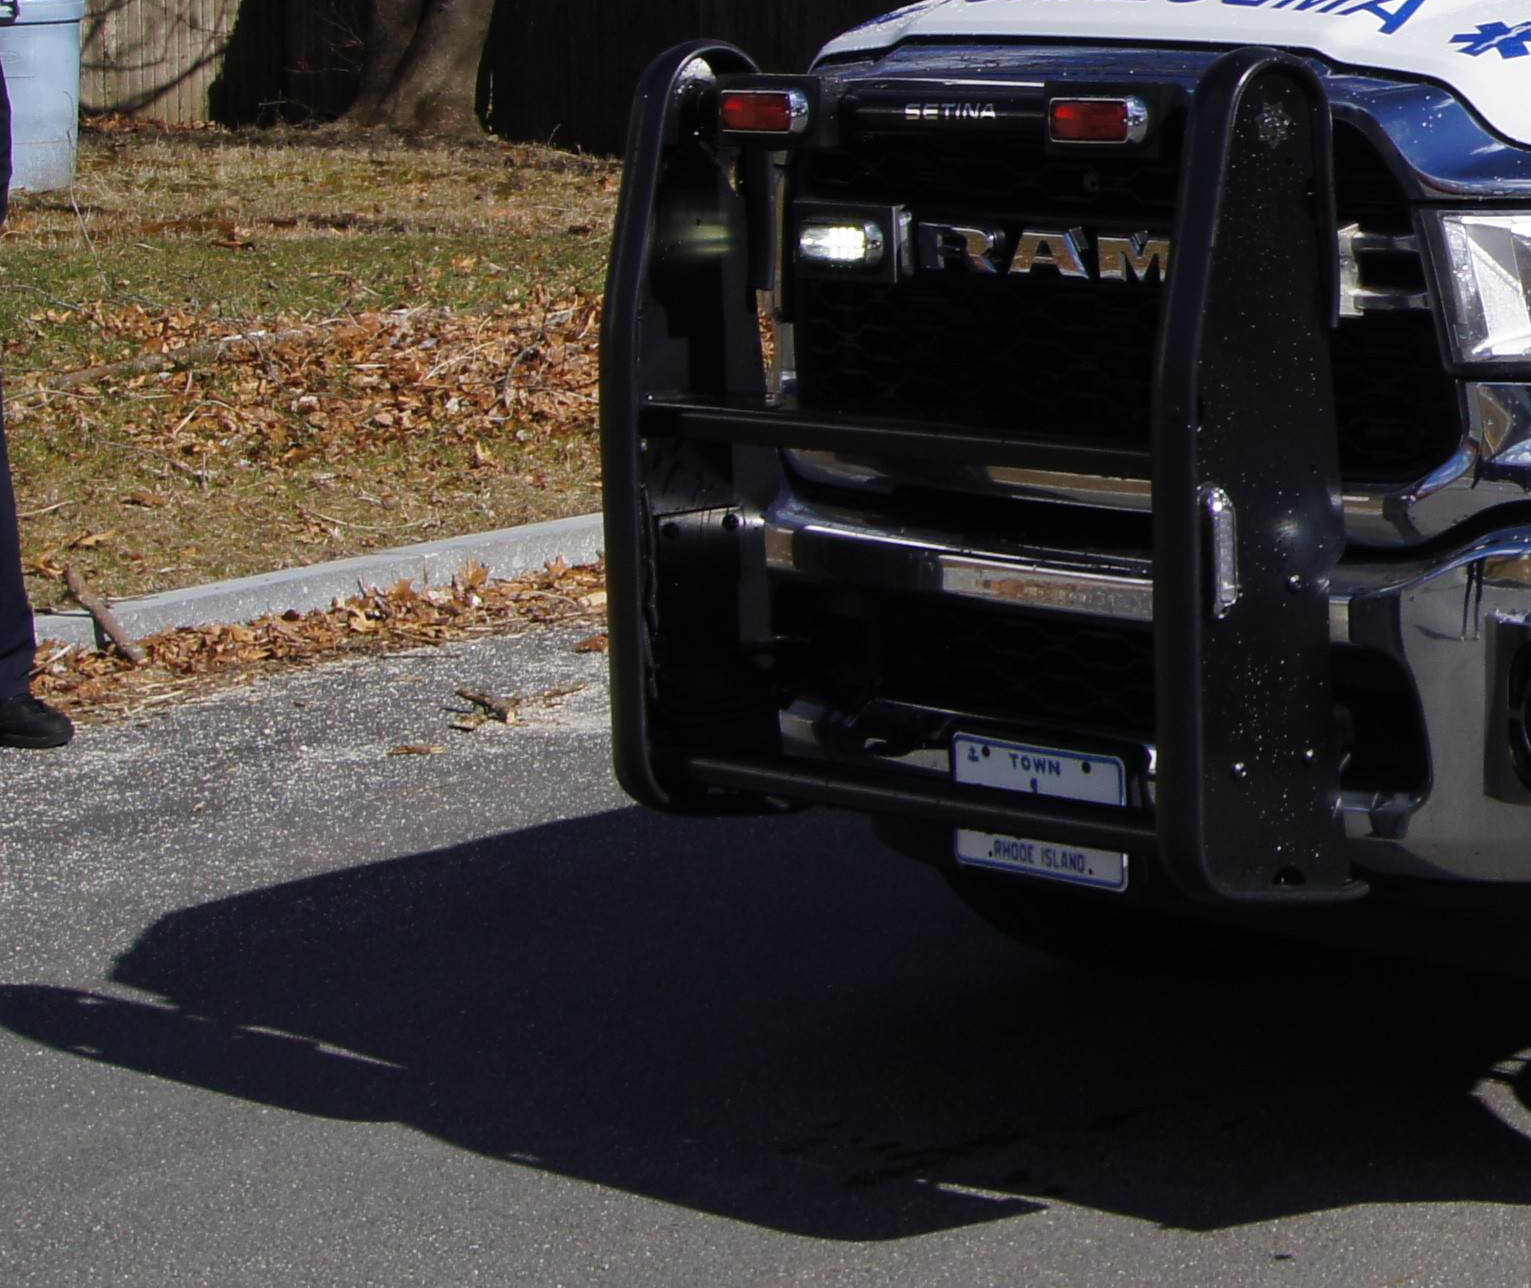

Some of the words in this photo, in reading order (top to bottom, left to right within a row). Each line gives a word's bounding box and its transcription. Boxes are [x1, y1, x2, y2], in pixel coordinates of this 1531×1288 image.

[904, 103, 997, 121] SETINA
[918, 221, 1172, 283] RAM
[1008, 752, 1062, 777] TOWN
[992, 839, 1035, 866] RHODE
[1040, 846, 1087, 874] ISLAND
